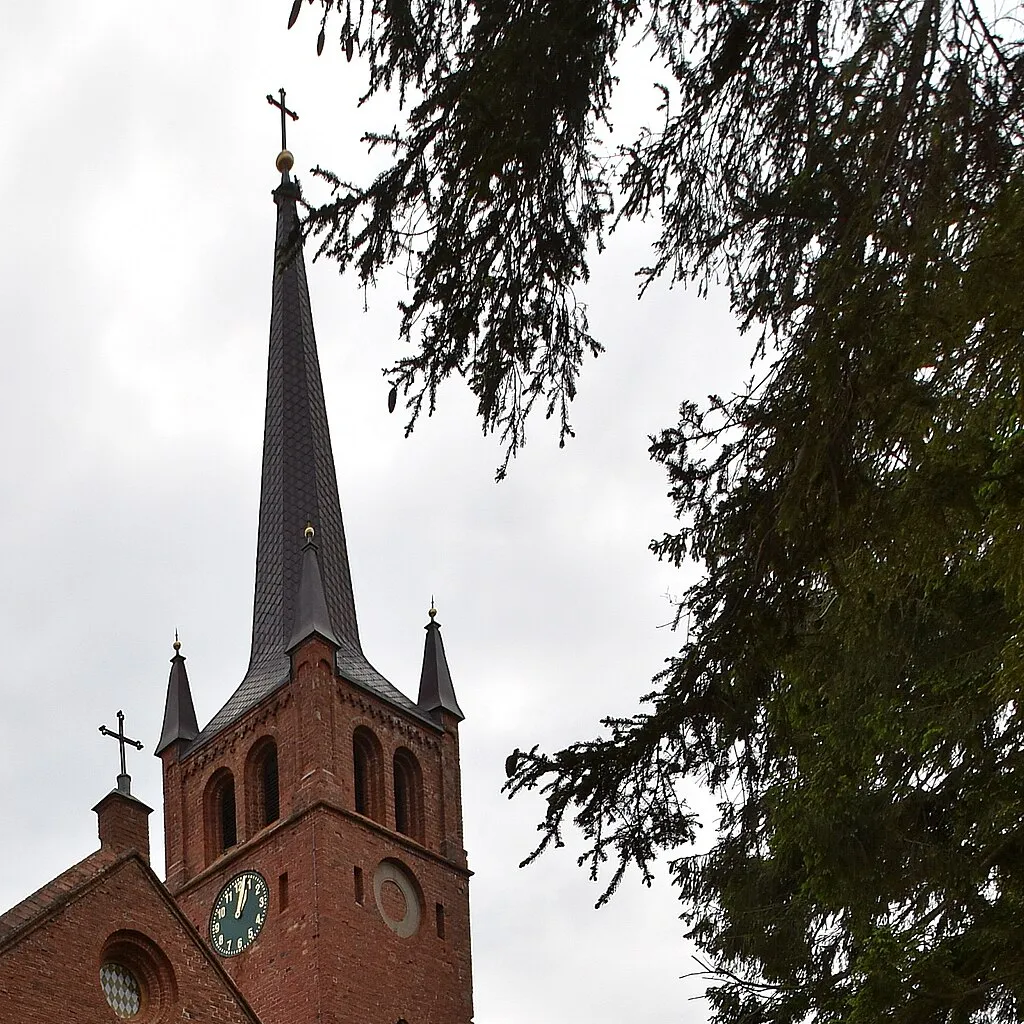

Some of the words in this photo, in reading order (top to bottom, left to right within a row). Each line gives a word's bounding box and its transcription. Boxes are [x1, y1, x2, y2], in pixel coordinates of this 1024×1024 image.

[247, 879, 251, 889] 1
[255, 884, 260, 895] 2
[225, 891, 232, 903] 11
[259, 897, 264, 907] 3
[217, 907, 225, 919] 10
[256, 914, 261, 924] 4
[214, 923, 219, 933] 9
[248, 928, 253, 938] 5
[218, 935, 223, 945] 8
[227, 940, 232, 950] 7
[237, 938, 242, 948] 6
